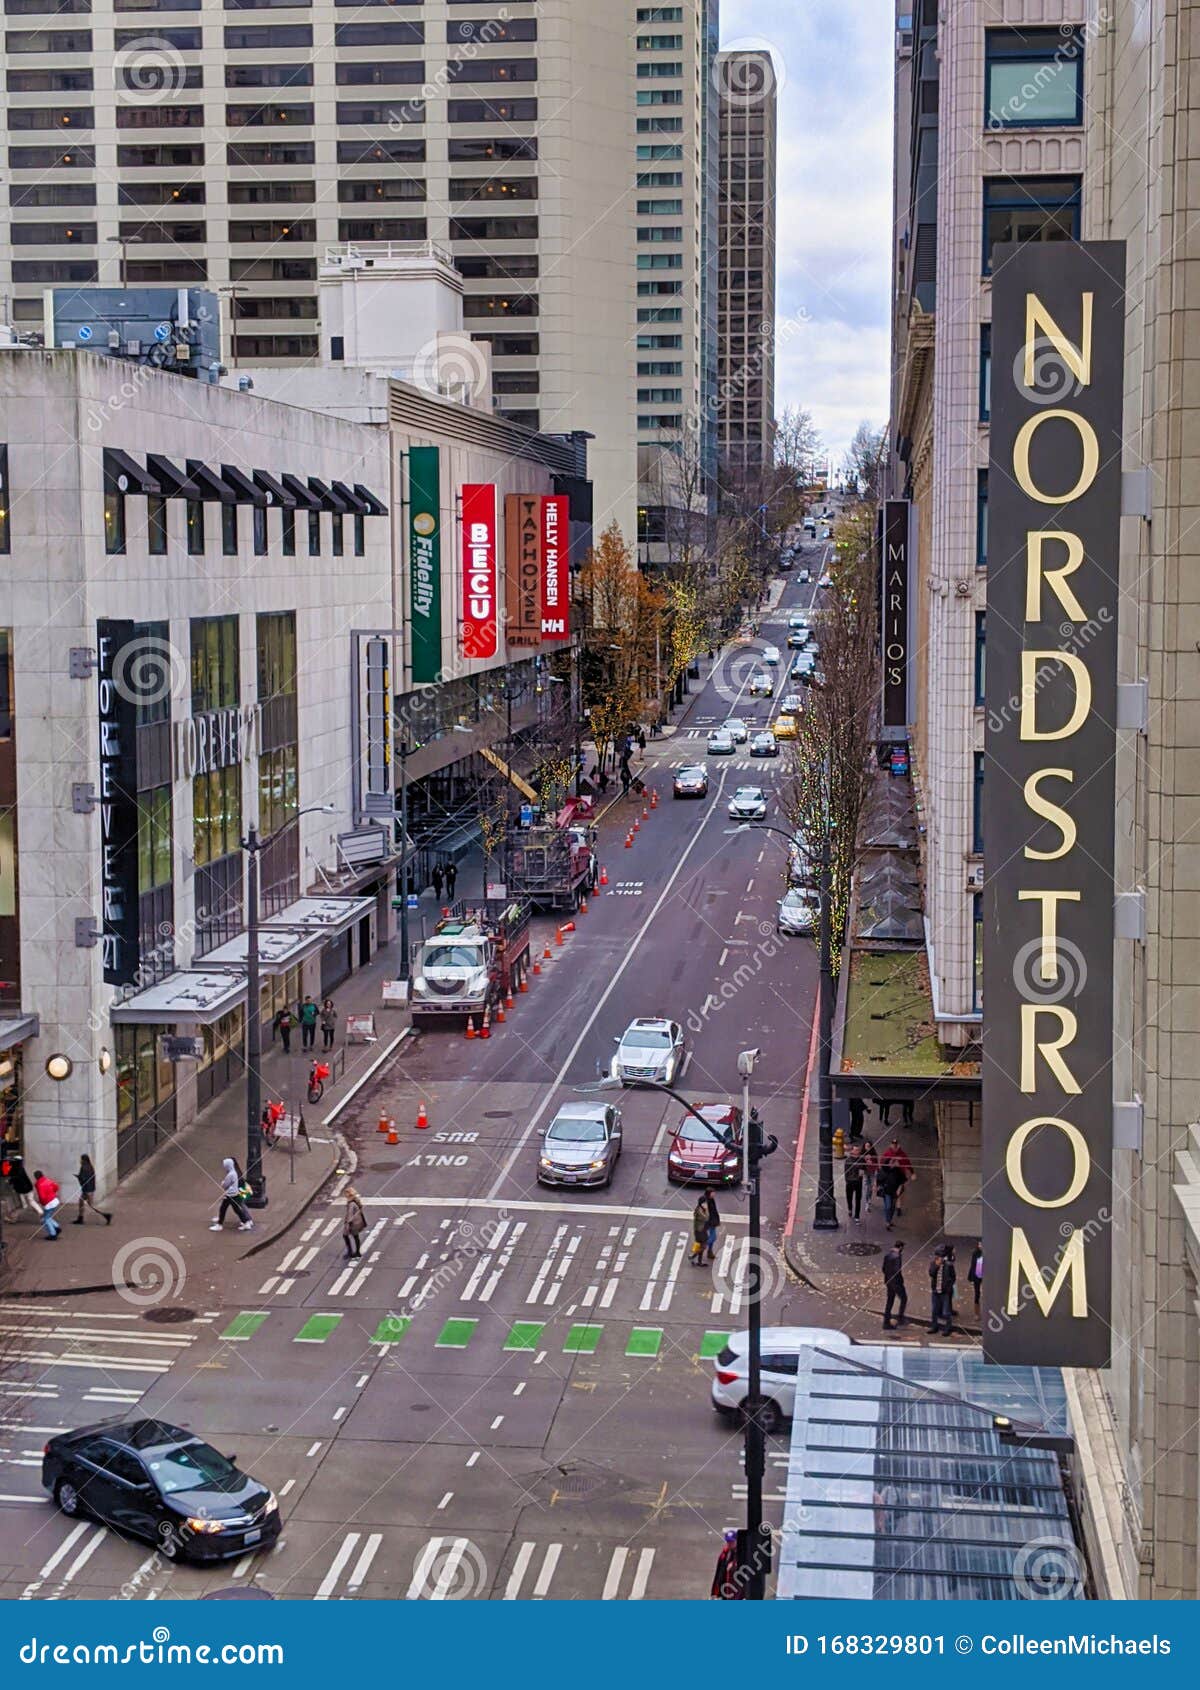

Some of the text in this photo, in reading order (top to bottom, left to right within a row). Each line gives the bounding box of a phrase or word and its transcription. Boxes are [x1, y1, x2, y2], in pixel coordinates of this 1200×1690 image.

[414, 536, 433, 618] Fidelity
[470, 523, 490, 619] BECU
[522, 501, 538, 623] TAPHOUSE
[546, 502, 558, 607] HELLY HANSEN
[508, 635, 539, 646] GRILL
[887, 543, 905, 686] MARIO'S
[174, 706, 246, 783] FOREVER
[100, 637, 118, 970] FOREVER 21
[1006, 291, 1099, 1318] NORDSTROM
[407, 1155, 469, 1166] ONLY
[432, 1132, 479, 1143] BUS
